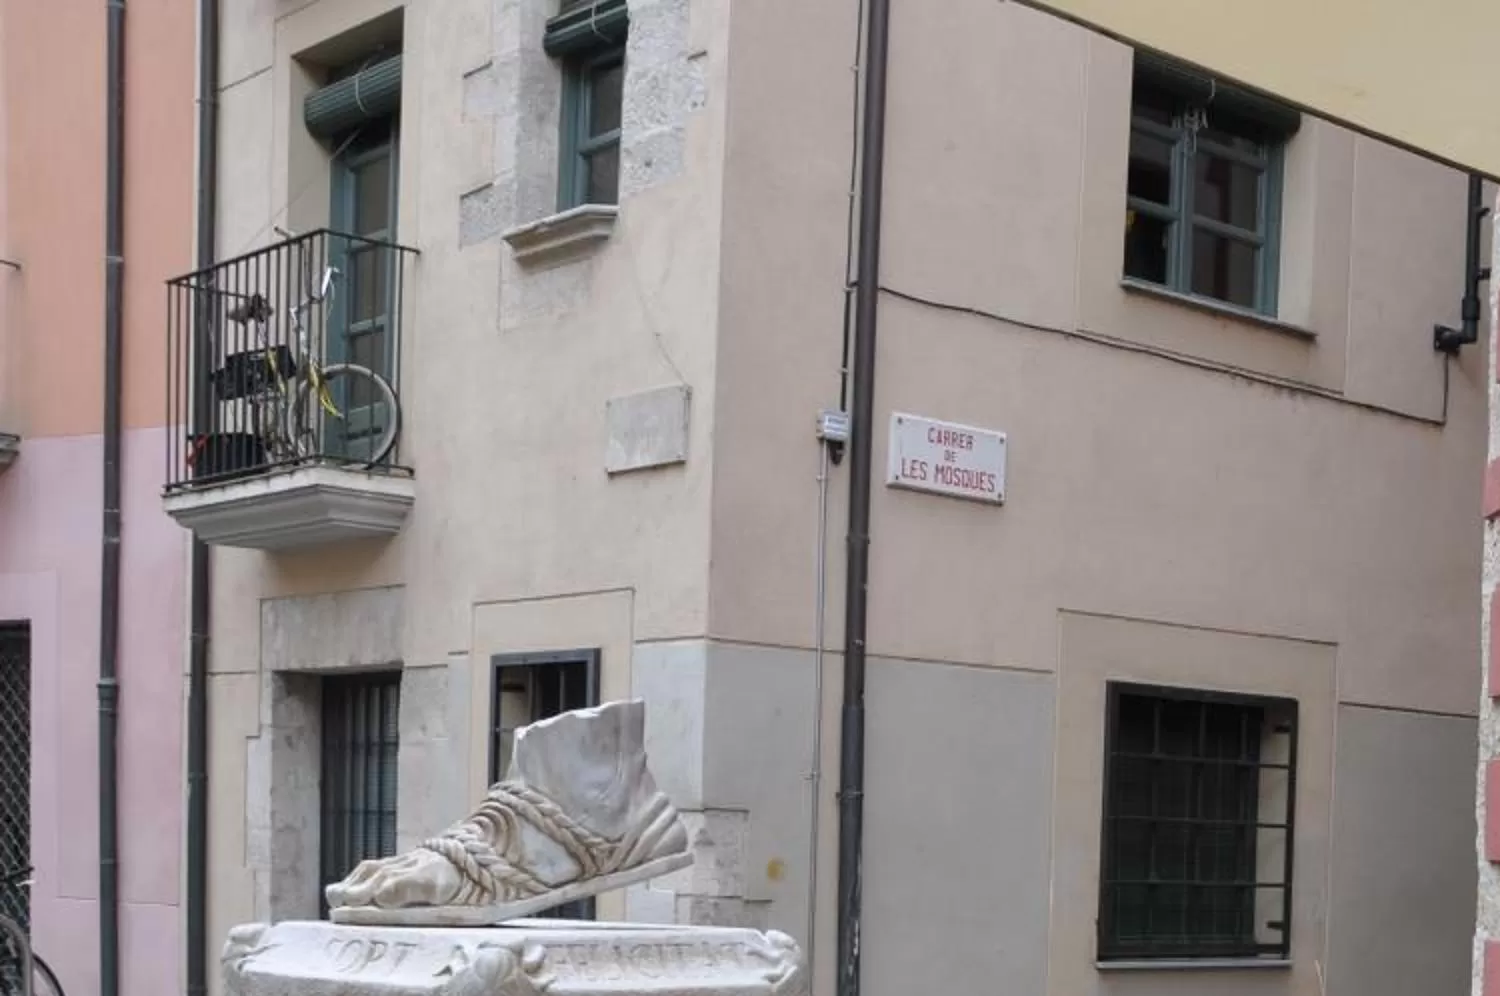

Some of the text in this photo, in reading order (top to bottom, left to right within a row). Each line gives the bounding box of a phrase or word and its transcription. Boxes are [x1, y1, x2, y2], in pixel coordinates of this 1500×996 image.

[927, 427, 974, 450] CARRER
[943, 449, 957, 463] DE
[901, 457, 996, 493] LES MOSQUES
